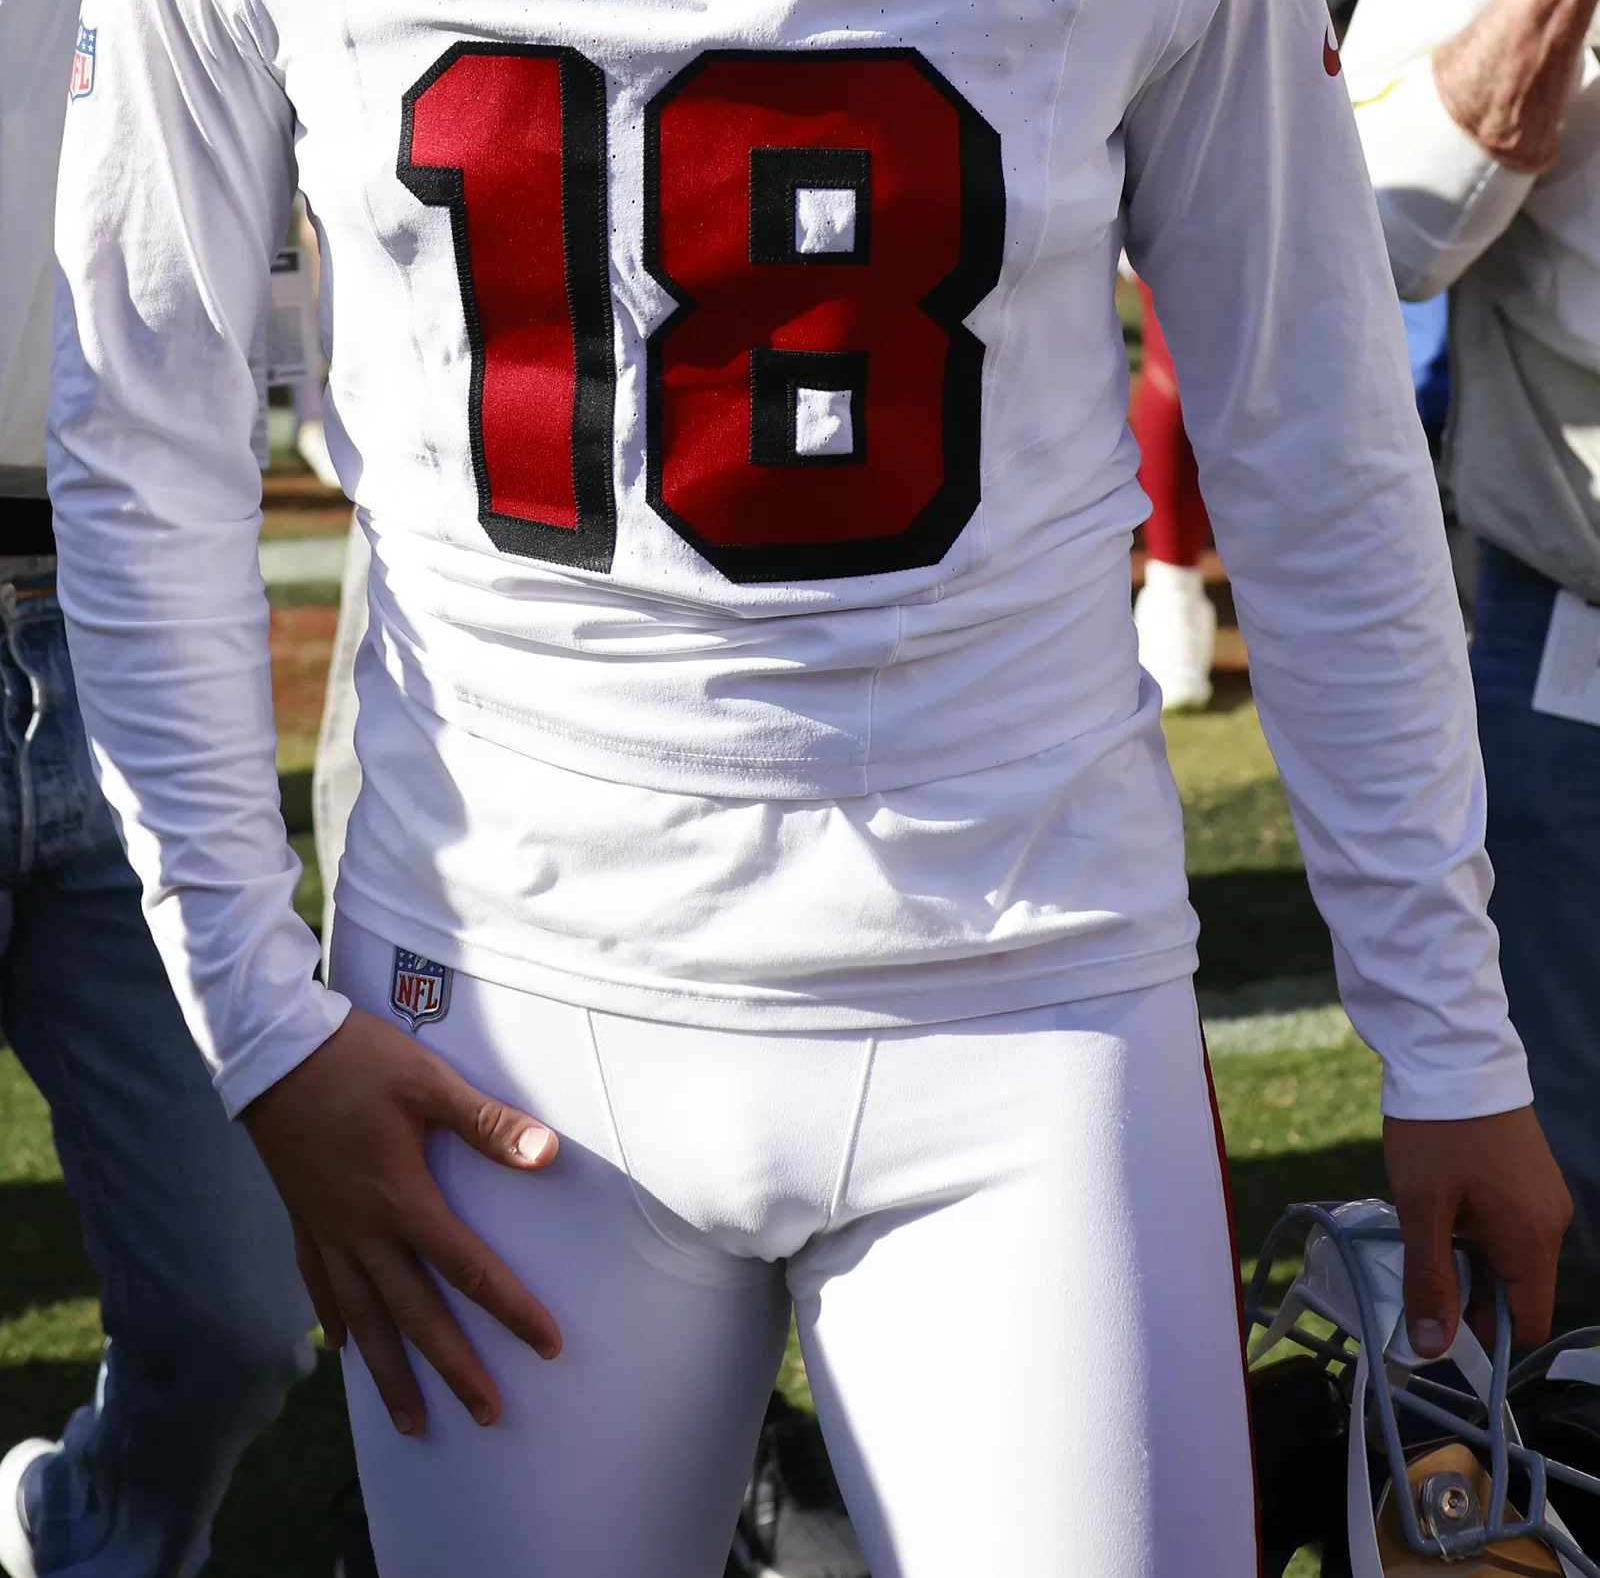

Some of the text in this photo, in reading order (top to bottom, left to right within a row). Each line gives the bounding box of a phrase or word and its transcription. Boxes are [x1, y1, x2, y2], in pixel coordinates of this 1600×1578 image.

[69, 51, 90, 93] FL
[396, 39, 1006, 583] 18
[396, 972, 439, 1014] NFL
